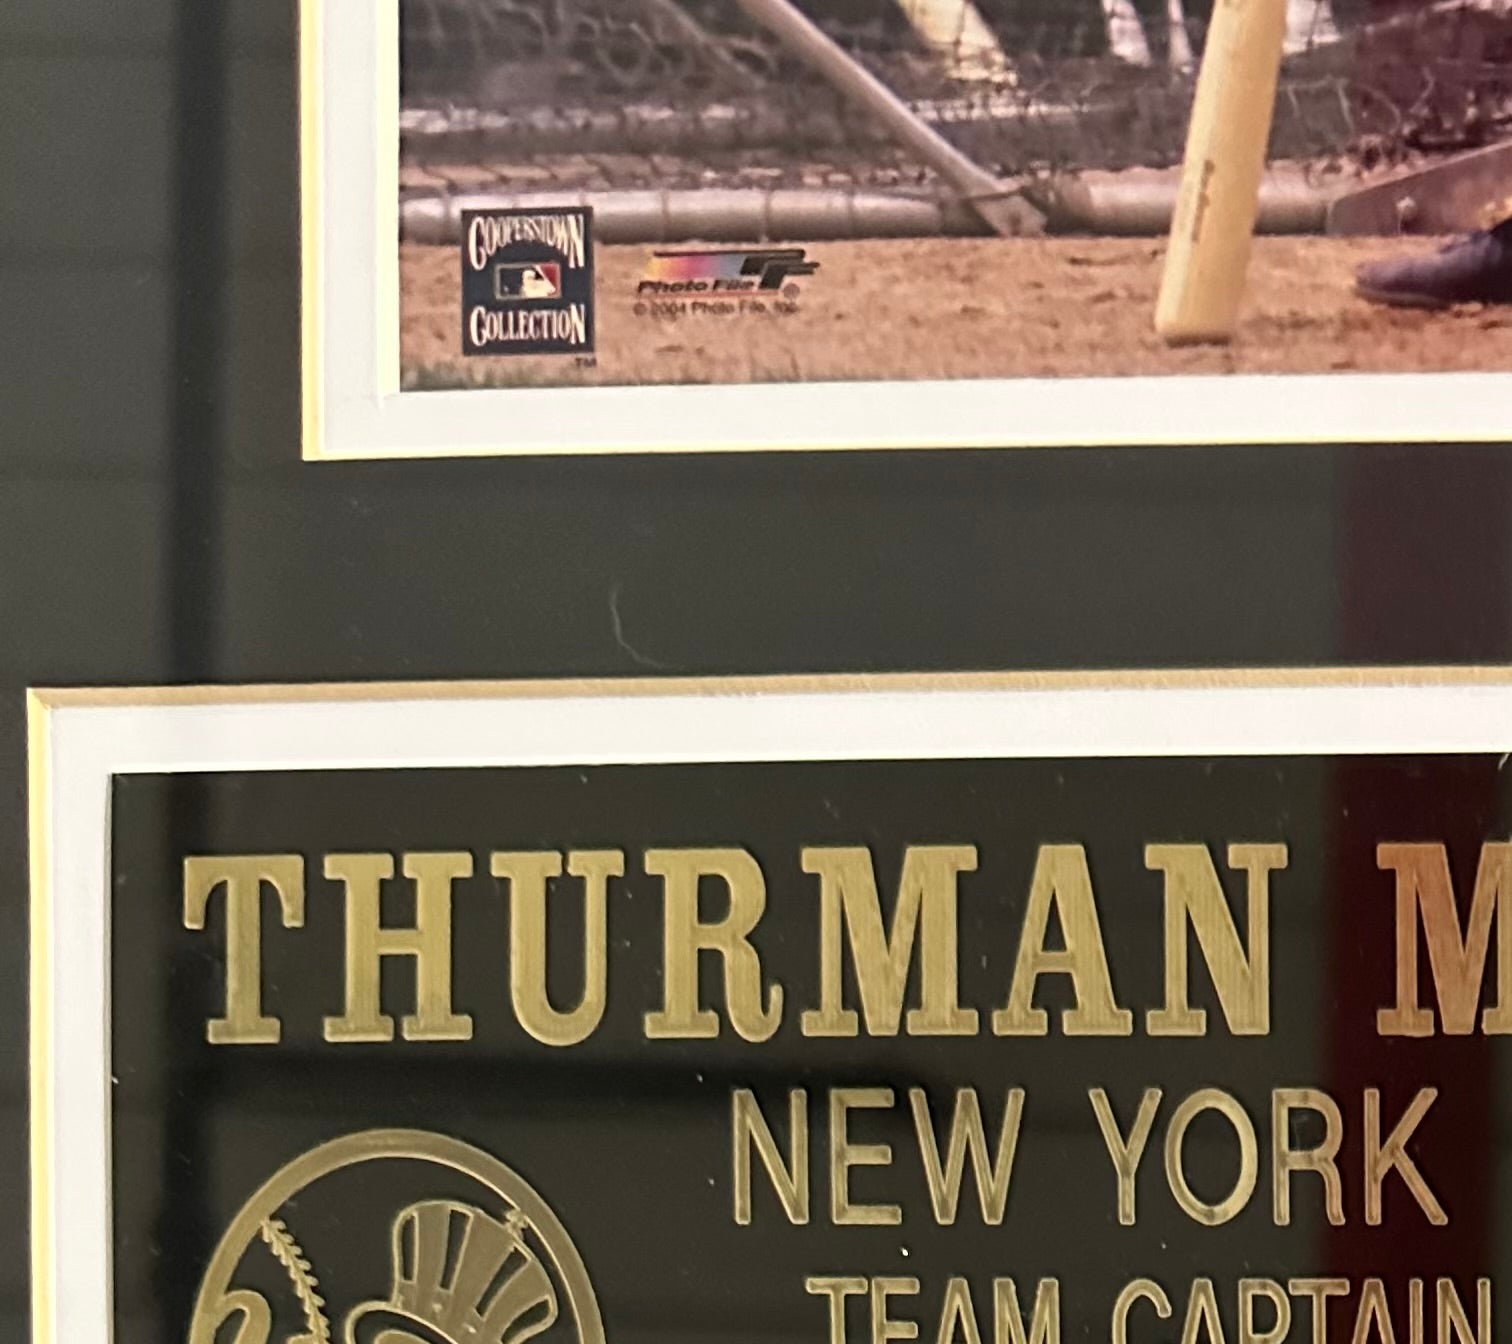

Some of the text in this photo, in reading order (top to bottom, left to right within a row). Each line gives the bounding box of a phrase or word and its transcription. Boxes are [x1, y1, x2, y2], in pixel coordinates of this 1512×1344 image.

[467, 214, 585, 270] COOPERSTOWN
[638, 279, 755, 293] Photo File
[470, 304, 586, 346] COLLECTION
[182, 842, 1289, 1046] THURMAN
[732, 1087, 1026, 1226] NEW
[1087, 1087, 1449, 1227] YORK
